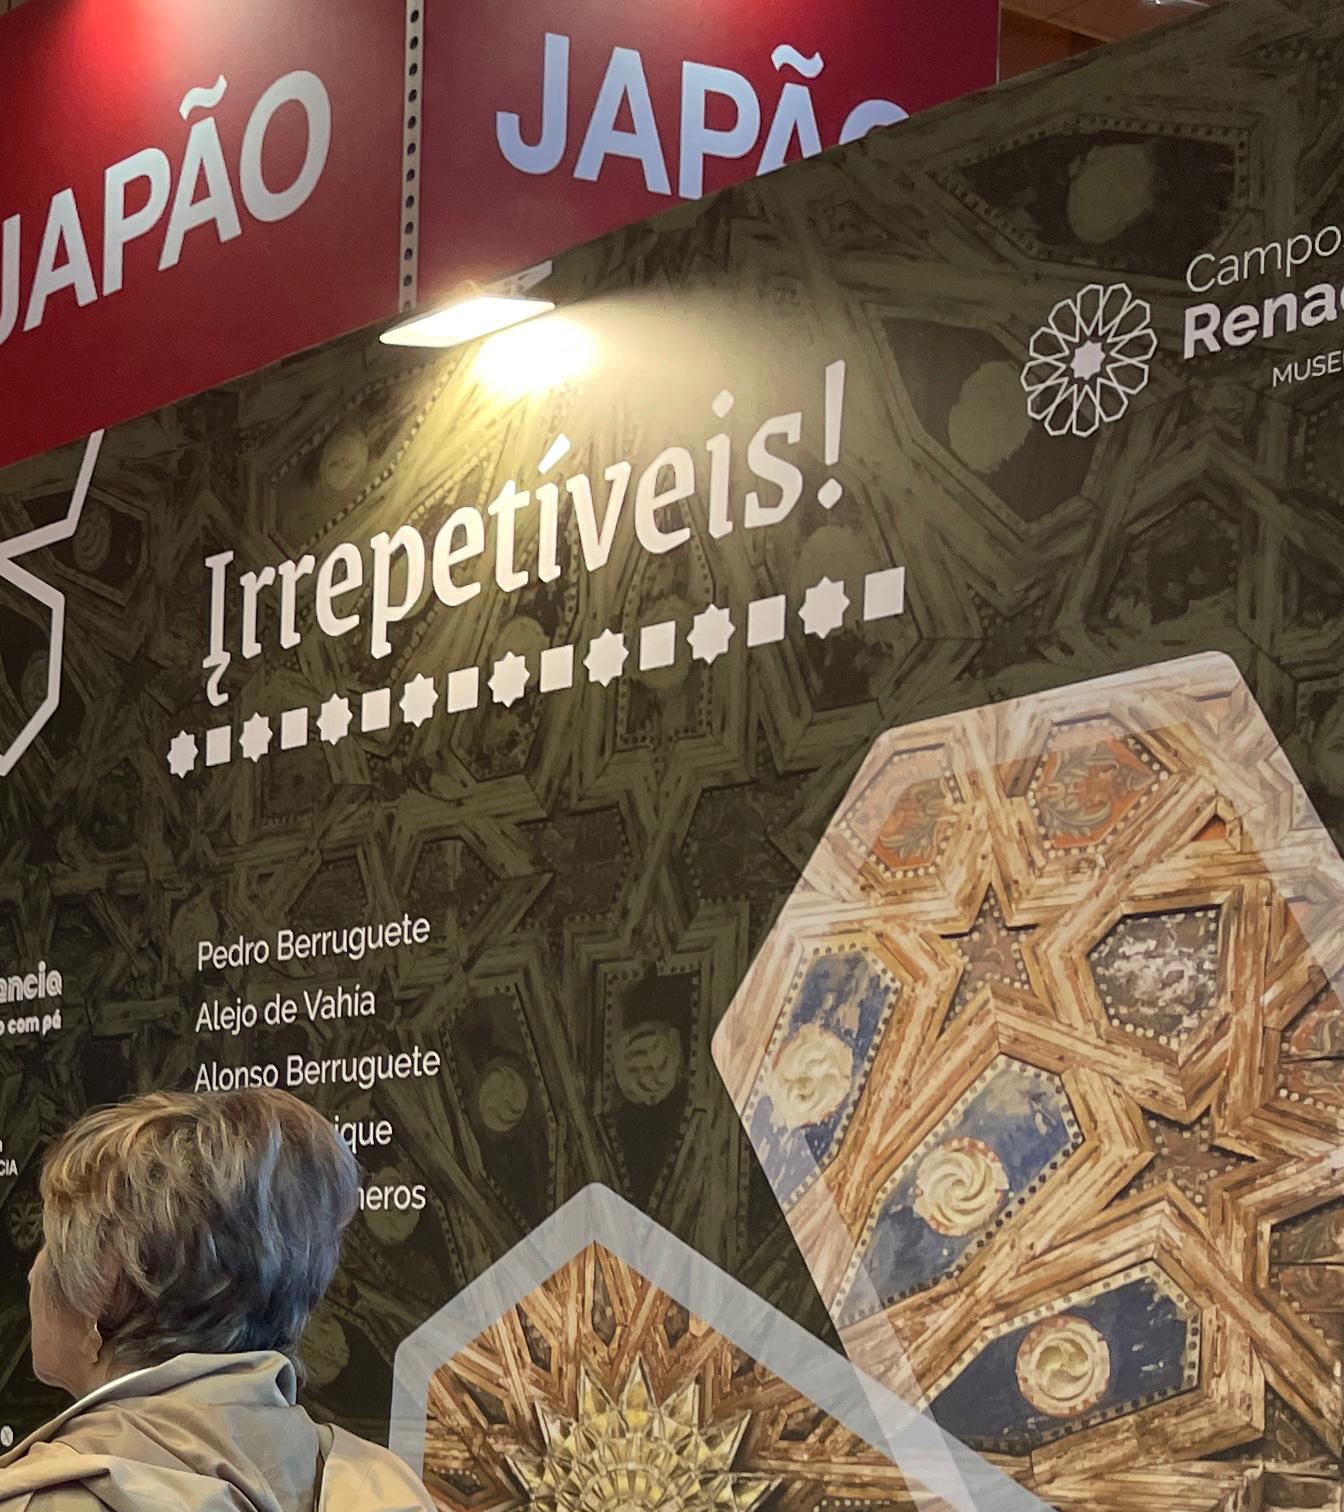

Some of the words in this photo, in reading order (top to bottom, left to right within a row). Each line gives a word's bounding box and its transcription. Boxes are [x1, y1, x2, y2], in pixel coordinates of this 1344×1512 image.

[1186, 226, 1344, 292] Campo
[1184, 283, 1344, 360] Rena
[1272, 350, 1344, 387] MUSE
[198, 936, 270, 971] Pedro
[277, 913, 431, 960] Berruguete
[8, 1016, 40, 1034] com
[195, 997, 258, 1035] Alejo
[264, 993, 298, 1025] de
[304, 984, 376, 1021] Vahía
[194, 1062, 279, 1093] Alonso
[286, 1045, 441, 1089] Berruguete
